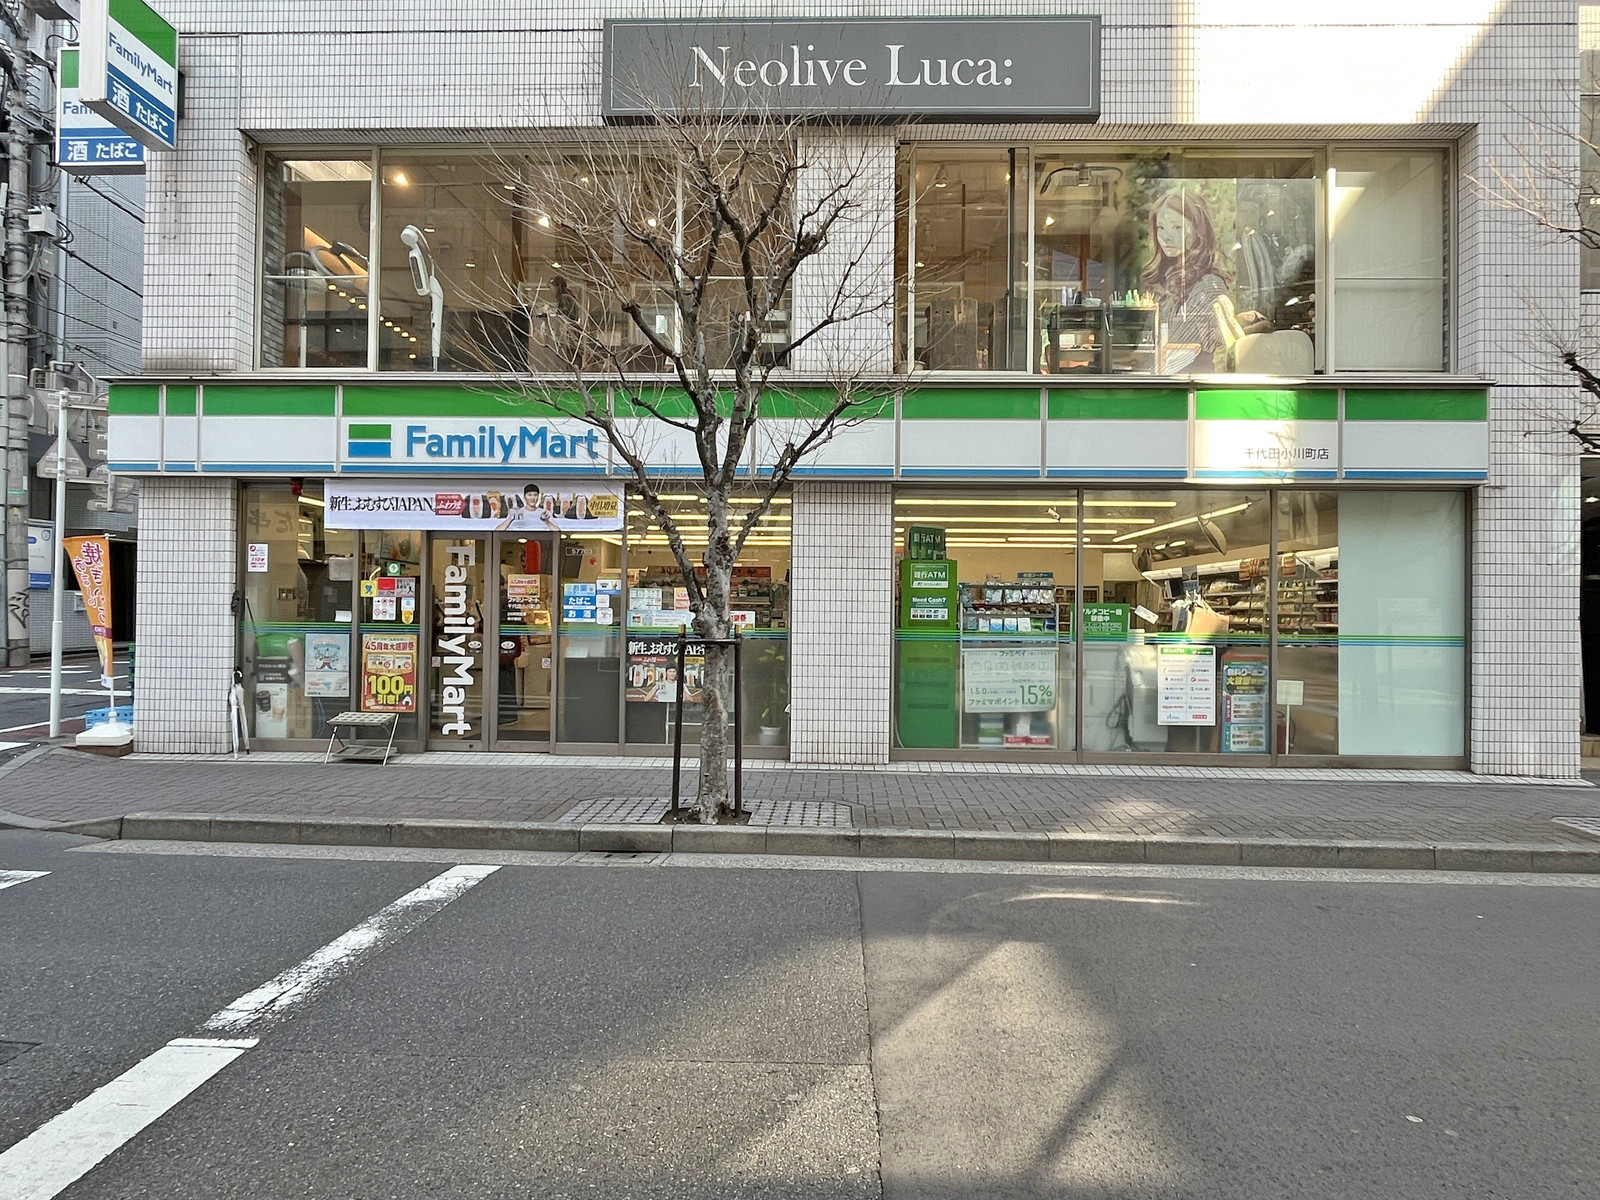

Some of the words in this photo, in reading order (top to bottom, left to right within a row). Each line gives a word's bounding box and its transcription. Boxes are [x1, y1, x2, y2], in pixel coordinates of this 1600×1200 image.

[109, 32, 174, 96] FamilyMart
[689, 44, 868, 88] Neolive
[884, 44, 1014, 87] Luca:
[112, 81, 130, 113] 酒
[136, 101, 169, 138] たばこ
[67, 140, 88, 161] 酒
[95, 142, 137, 158] たばこ
[406, 425, 599, 463] FamilyMart
[1244, 447, 1330, 460] 千代田小川町店
[568, 596, 592, 605] たばこ
[438, 546, 476, 735] FamilyMart
[368, 675, 414, 695] 100円
